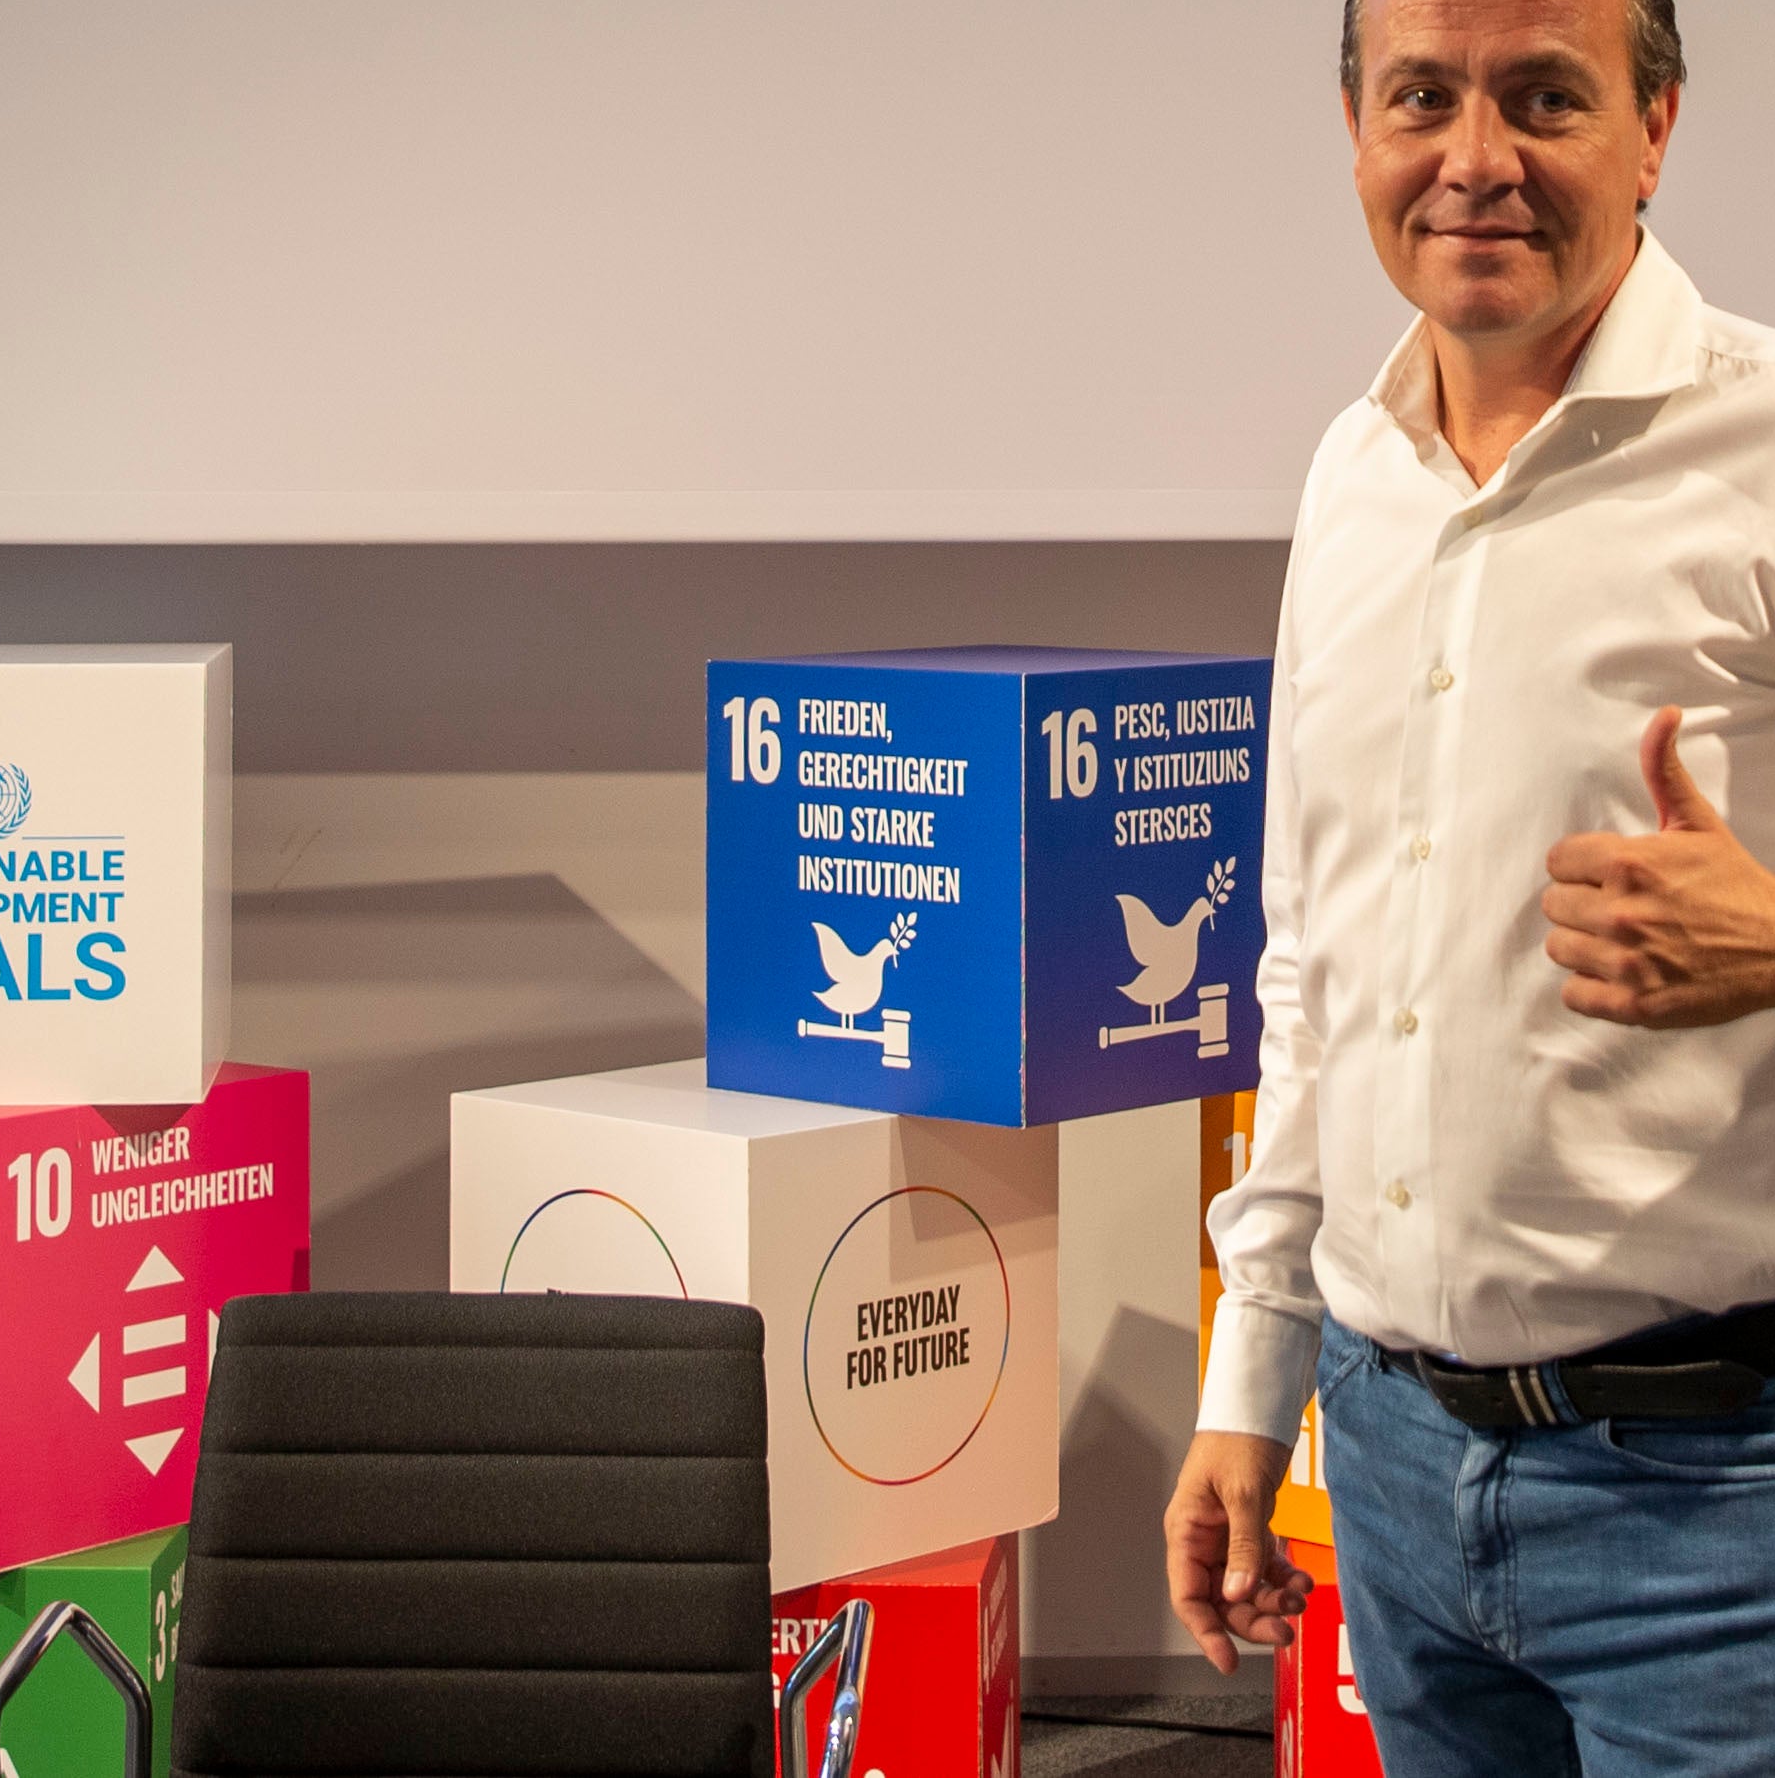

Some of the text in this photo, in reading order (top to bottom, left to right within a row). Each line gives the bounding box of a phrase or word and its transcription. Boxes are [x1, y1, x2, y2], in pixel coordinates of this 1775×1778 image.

[722, 697, 782, 784] 16
[798, 698, 893, 743] FRIEDEN,
[1114, 696, 1255, 741] PESC, IUSTIZIA
[797, 750, 969, 797] GERECHTIGKEIT
[1040, 708, 1098, 800] 16
[1114, 747, 1250, 795] Y ISTITUZIUNS
[797, 803, 935, 848] UND STARKE
[1113, 804, 1212, 847] STERSCES
[797, 855, 961, 904] INSTITUTIONEN
[92, 1127, 191, 1175] WENIGER
[8, 1147, 73, 1242] 10
[91, 1163, 274, 1228] UNGLEICHHEITEN
[857, 1285, 961, 1343] EVERYDAY
[847, 1327, 971, 1389] FOR FUTURE
[155, 1590, 166, 1682] 3
